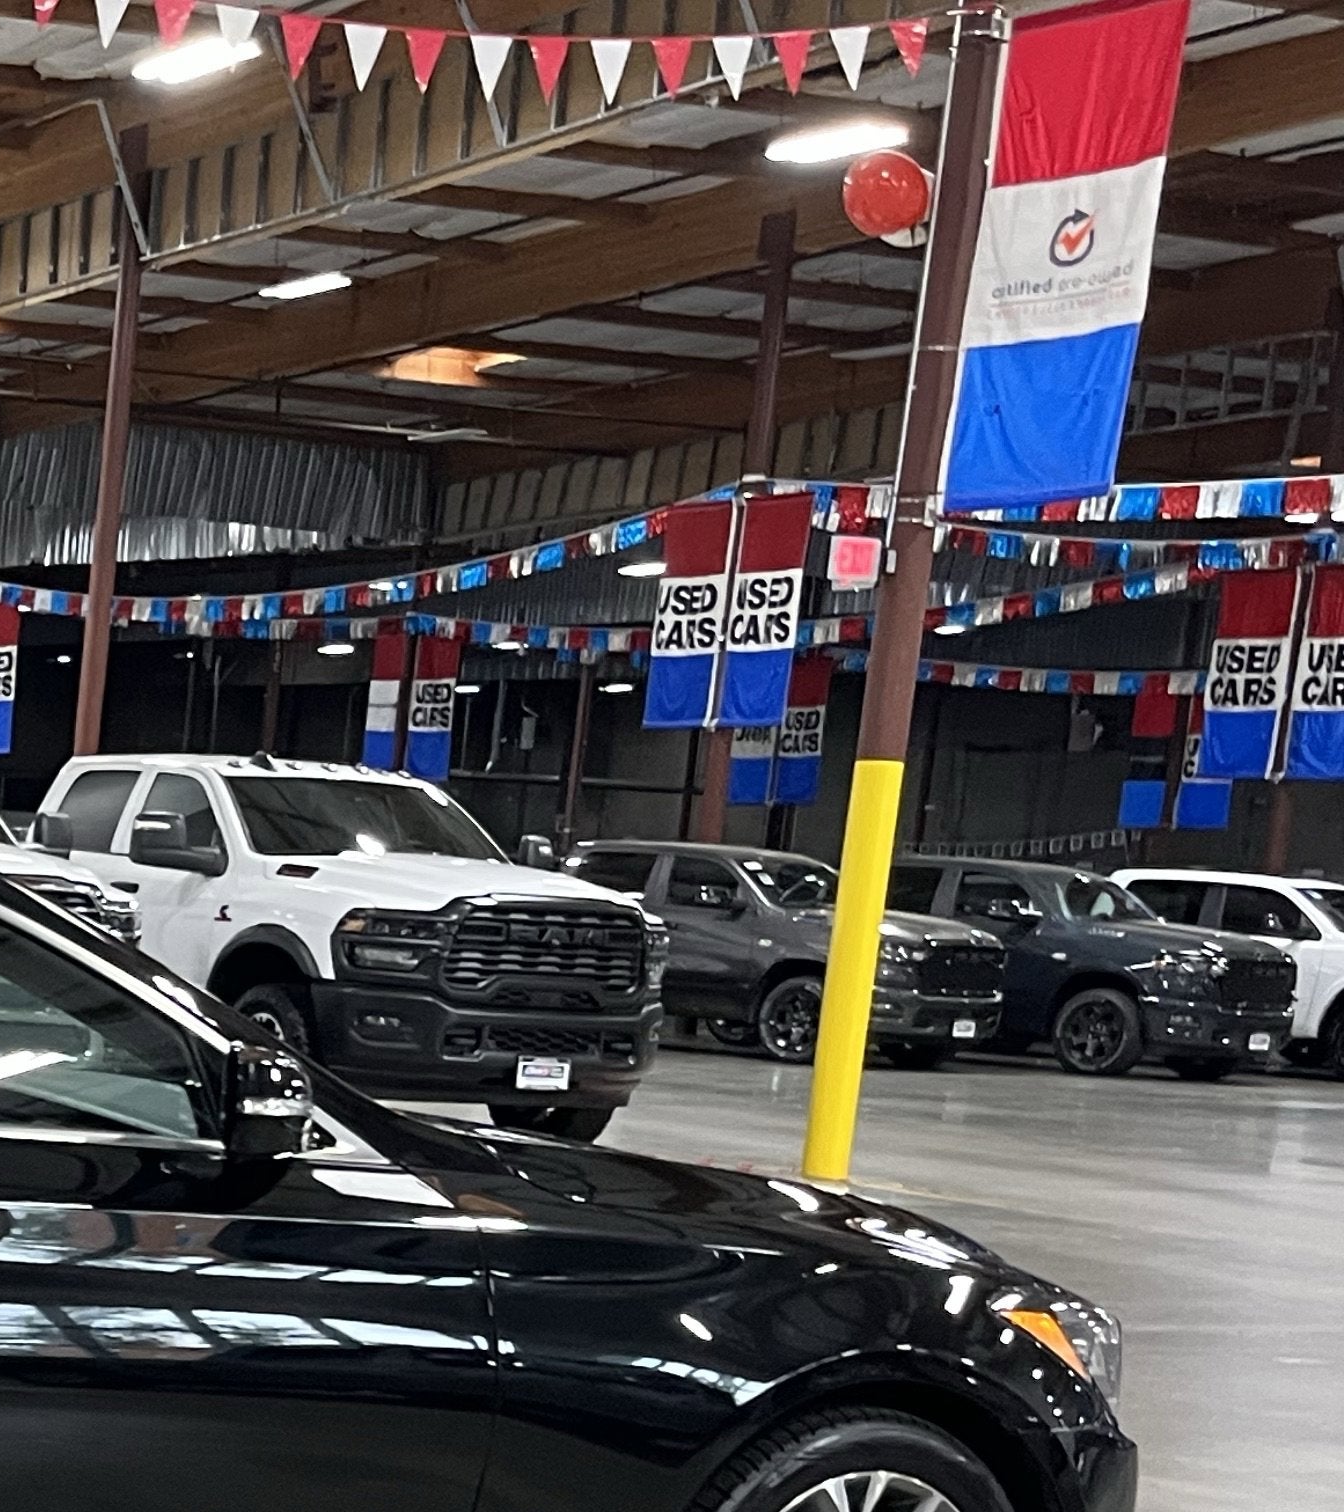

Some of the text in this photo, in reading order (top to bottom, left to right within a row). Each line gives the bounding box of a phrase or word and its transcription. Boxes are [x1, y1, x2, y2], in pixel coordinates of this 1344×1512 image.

[657, 583, 718, 615] USED
[655, 617, 717, 650] CARS
[729, 611, 791, 645] CARS
[1215, 644, 1282, 674] USED
[1308, 643, 1344, 674] USE
[1209, 676, 1277, 706] CARS
[1302, 676, 1344, 706] CAR
